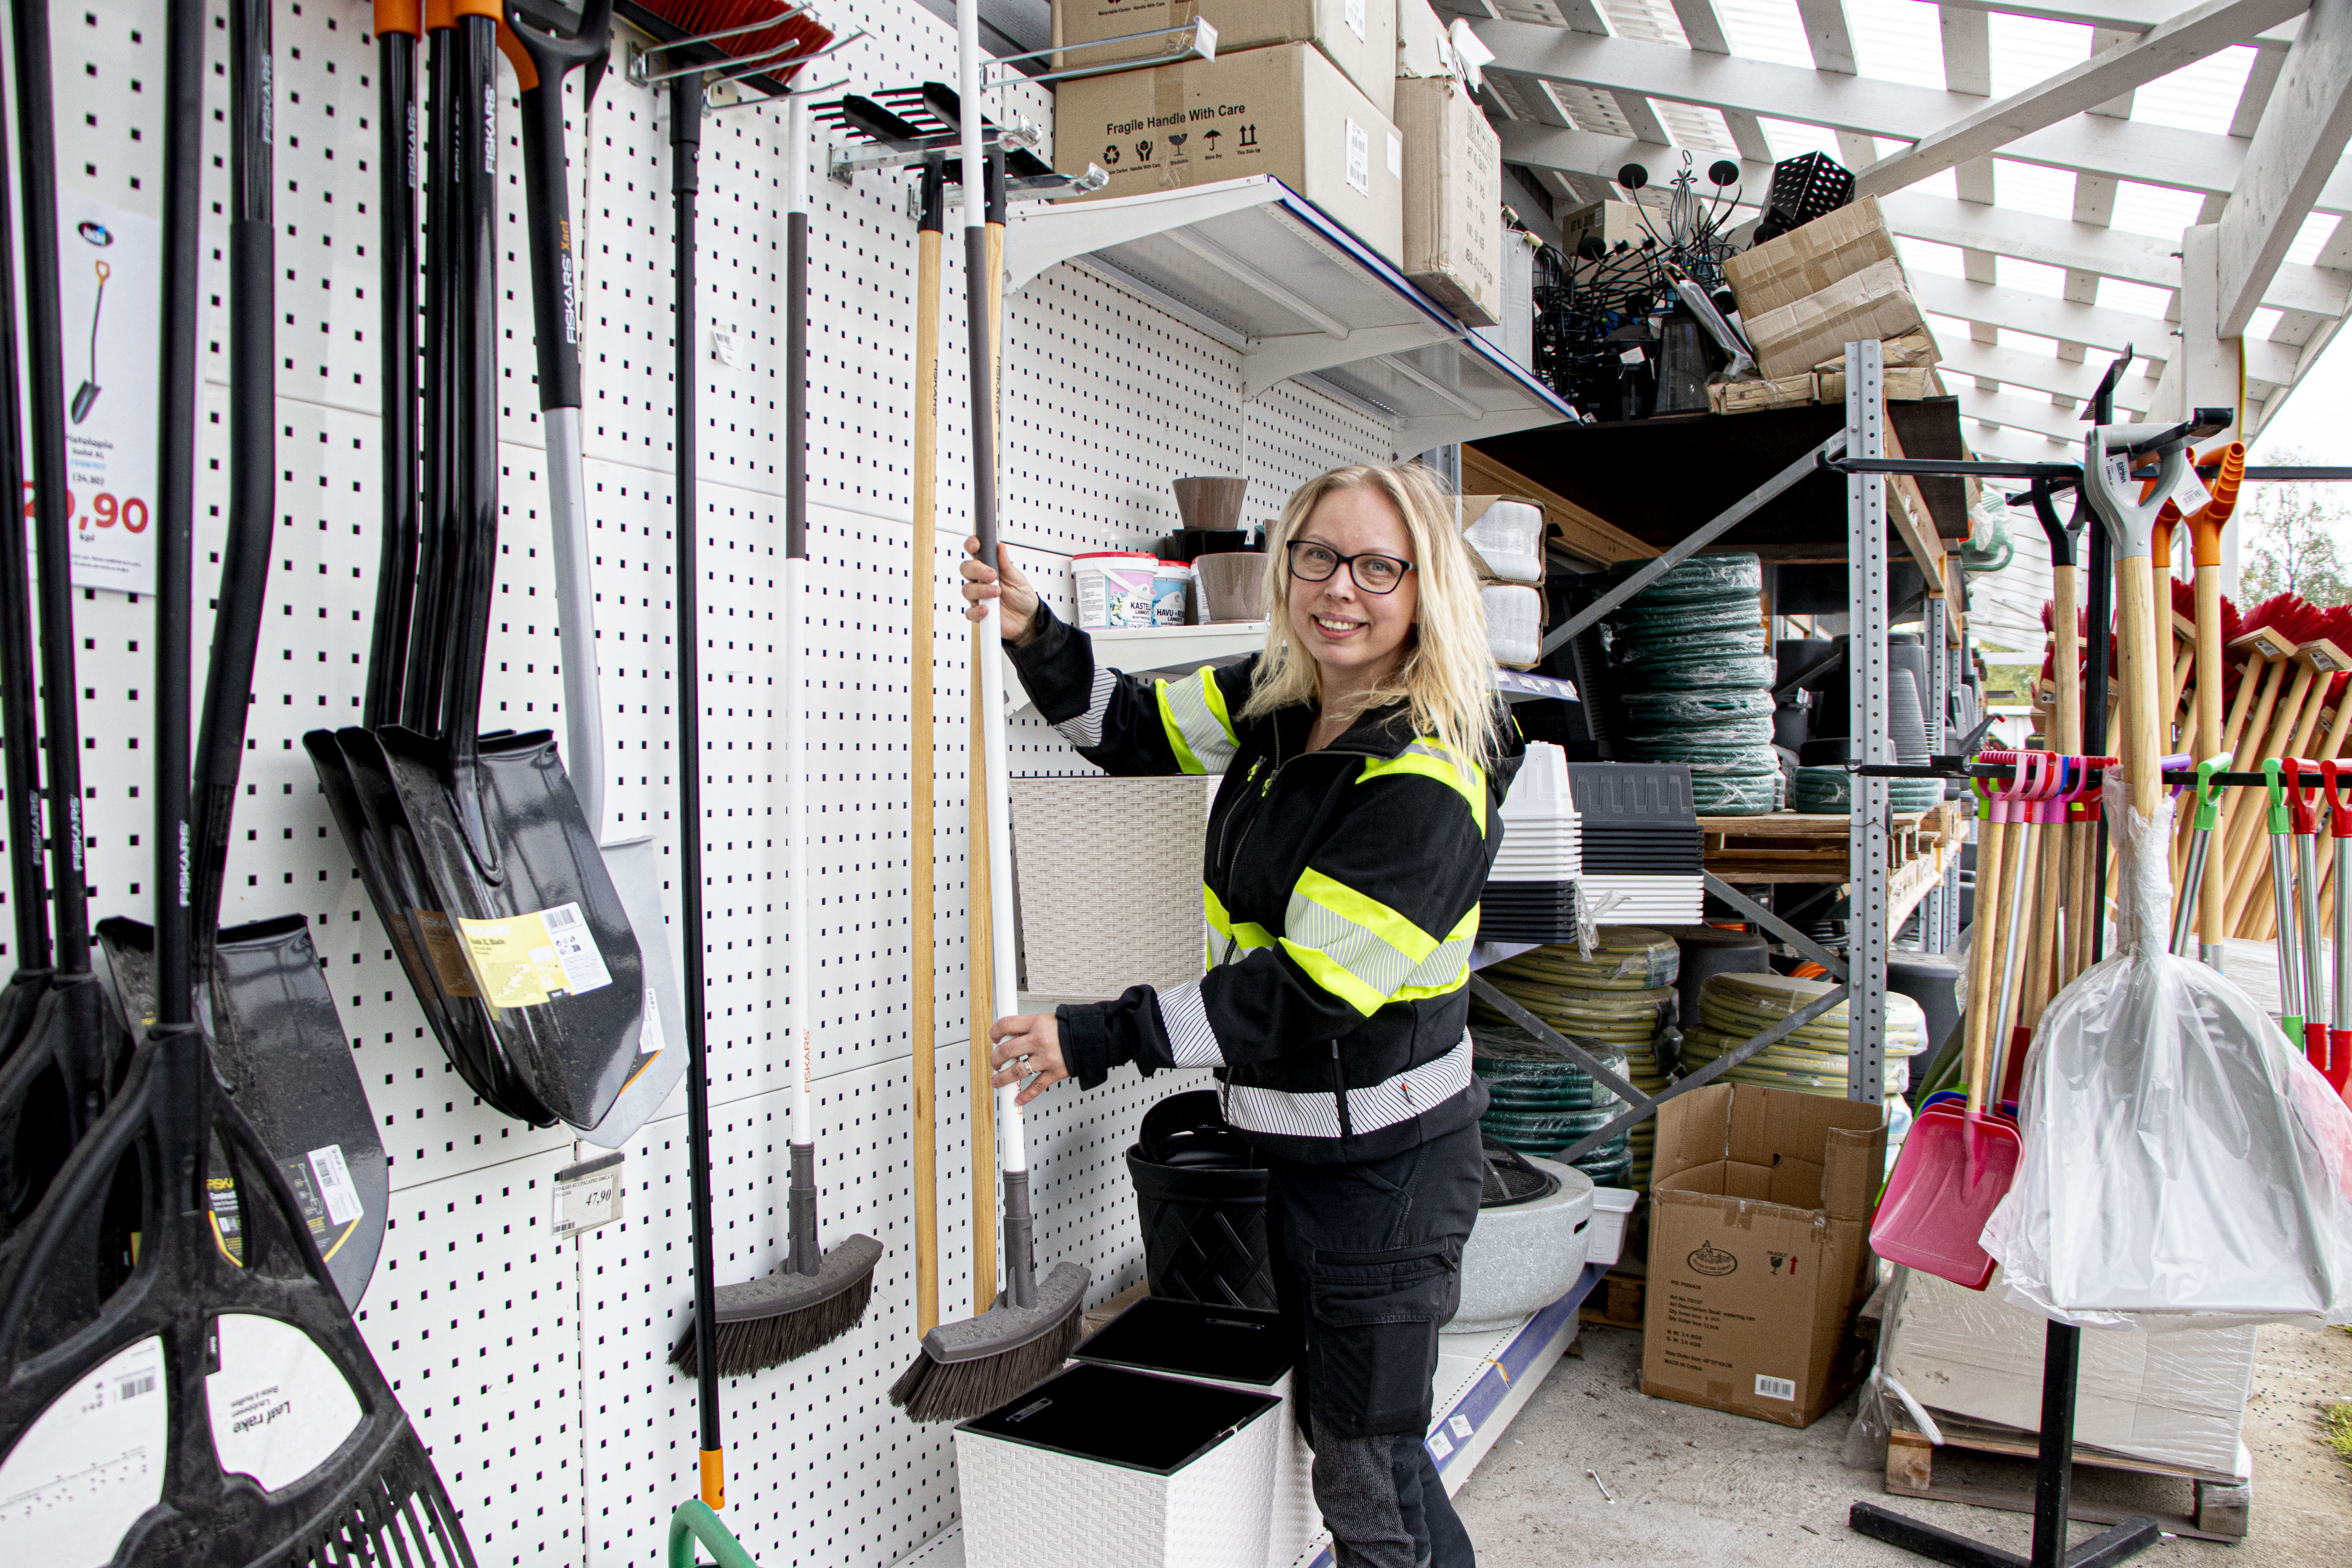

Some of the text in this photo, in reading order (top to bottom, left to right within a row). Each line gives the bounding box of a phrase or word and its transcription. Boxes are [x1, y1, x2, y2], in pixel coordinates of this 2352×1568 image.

[407, 100, 416, 189] FISKARS
[485, 84, 496, 175] FISKARS
[1107, 104, 1245, 135] Fragile Handle With Care
[560, 220, 577, 345] FISKARS Xact
[65, 434, 114, 449] istolapio
[29, 790, 42, 866] FISKARS
[70, 794, 83, 871] FISKARS
[179, 820, 191, 908] FISKARS
[464, 924, 511, 936] FISKARS
[586, 1189, 611, 1206] 47,90
[233, 1400, 290, 1433] Leaf rake
